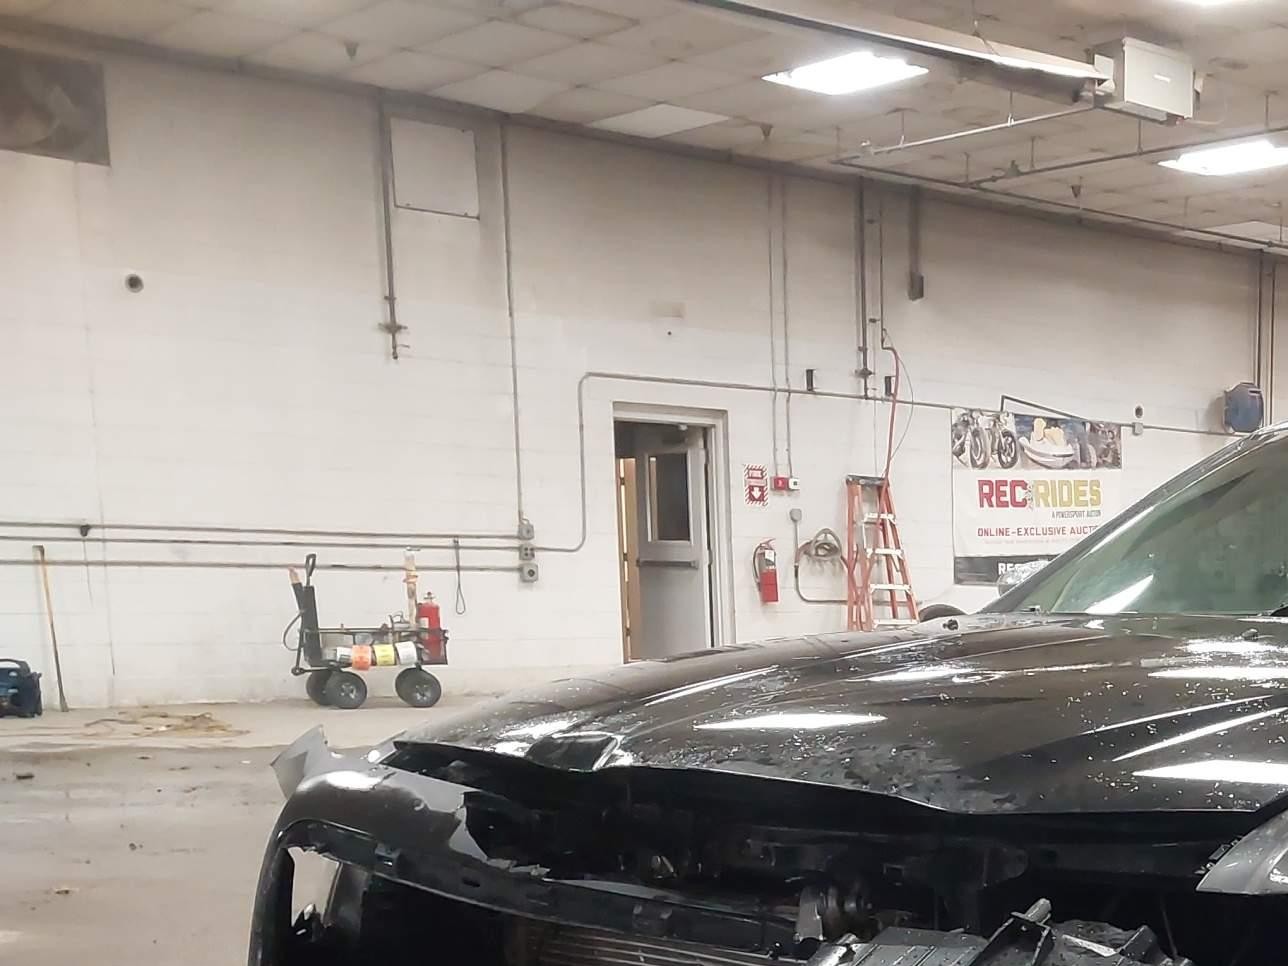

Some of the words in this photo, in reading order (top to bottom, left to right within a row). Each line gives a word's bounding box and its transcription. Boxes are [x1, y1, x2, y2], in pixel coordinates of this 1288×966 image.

[978, 480, 1028, 508] REC
[1033, 480, 1101, 508] RIDES
[977, 527, 1067, 537] ONLINE-EXCLUSIVE
